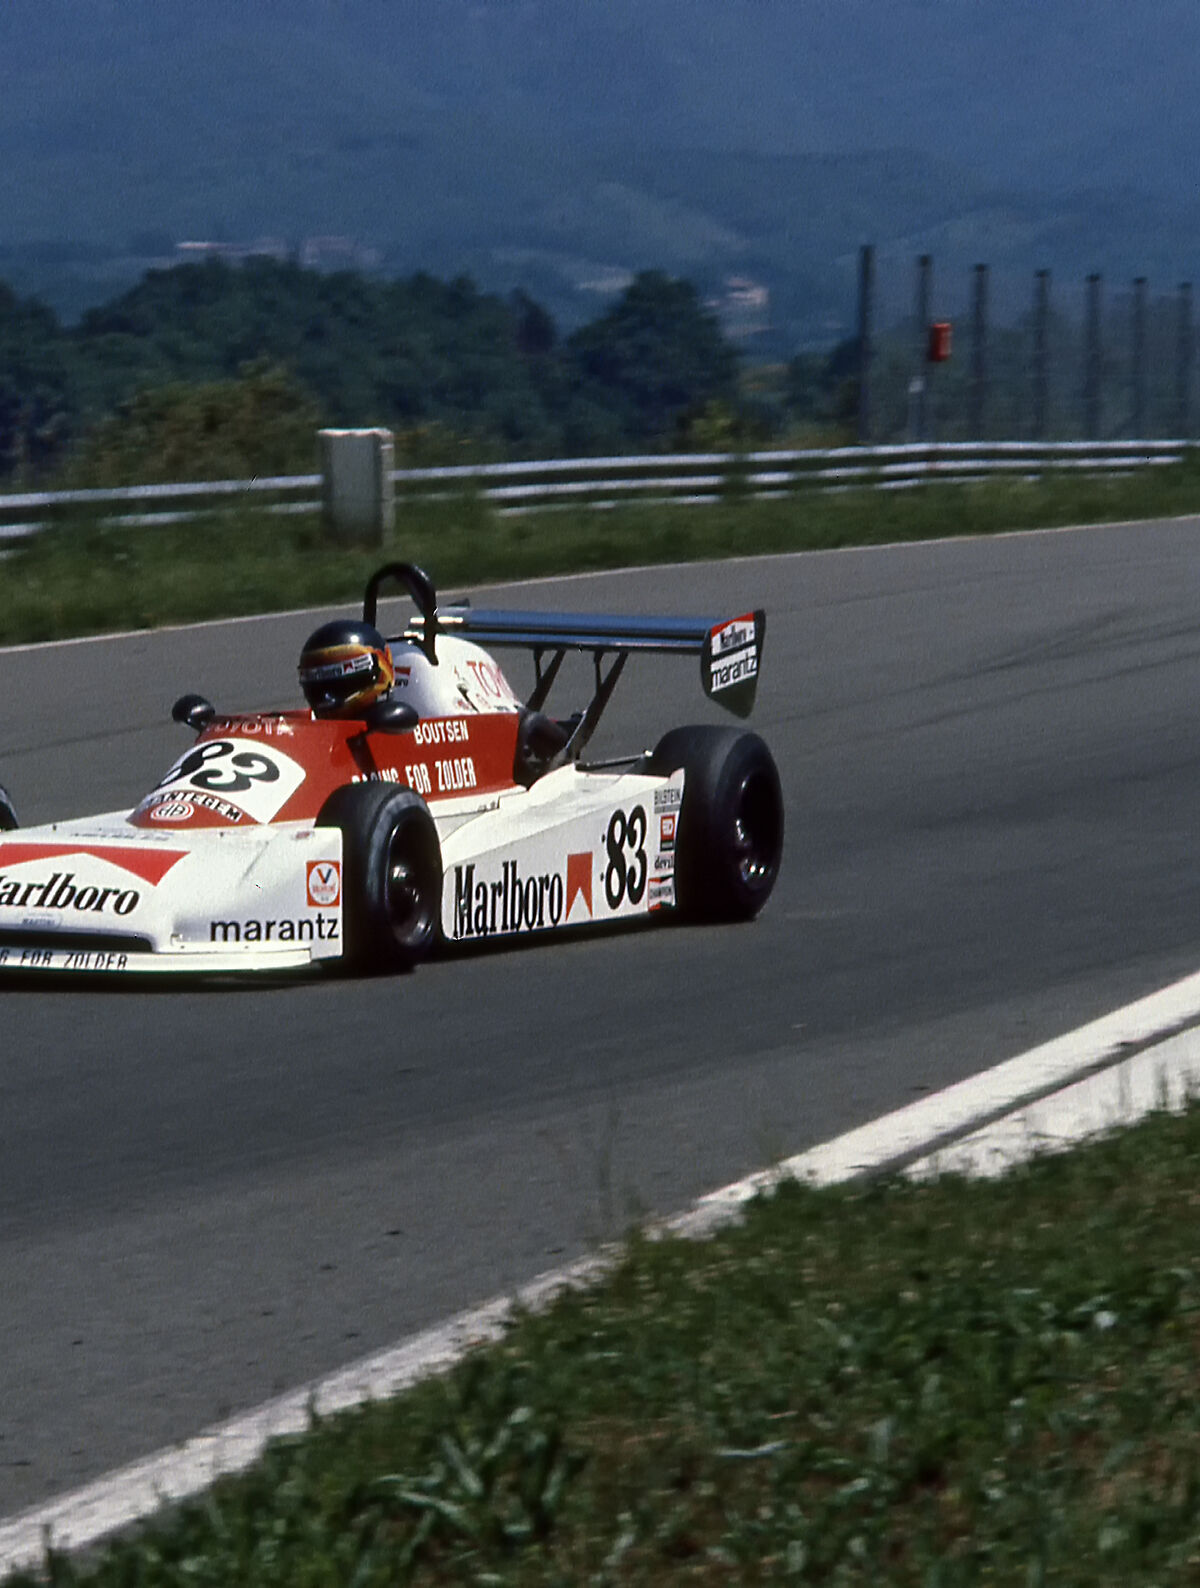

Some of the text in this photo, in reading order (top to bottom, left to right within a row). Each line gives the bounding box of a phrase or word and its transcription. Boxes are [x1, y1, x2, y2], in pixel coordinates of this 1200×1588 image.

[413, 720, 469, 745] BOUTSEN
[151, 740, 280, 792] 83
[405, 763, 432, 794] FOR
[435, 757, 477, 791] ZOLDER
[605, 805, 647, 910] 83
[453, 860, 563, 939] Marlboro
[210, 913, 339, 941] marantz
[20, 951, 53, 966] FOR
